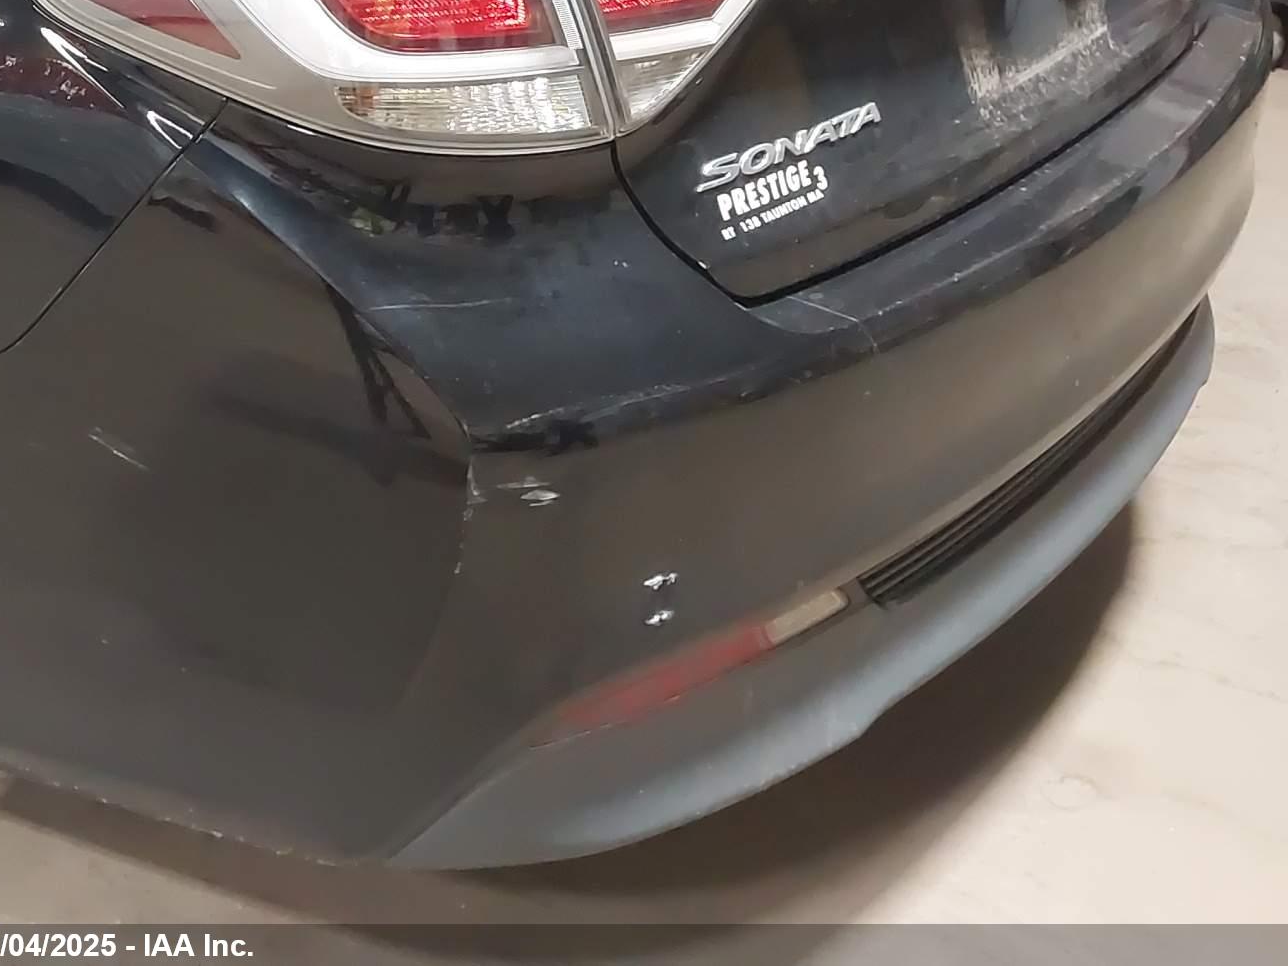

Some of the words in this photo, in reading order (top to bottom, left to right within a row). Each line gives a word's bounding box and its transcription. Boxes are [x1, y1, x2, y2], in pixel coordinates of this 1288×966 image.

[695, 102, 881, 192] SONATA
[716, 160, 812, 221] PRESTIGE
[813, 165, 829, 191] 3
[760, 196, 808, 224] TAUNTON
[806, 188, 825, 204] MA
